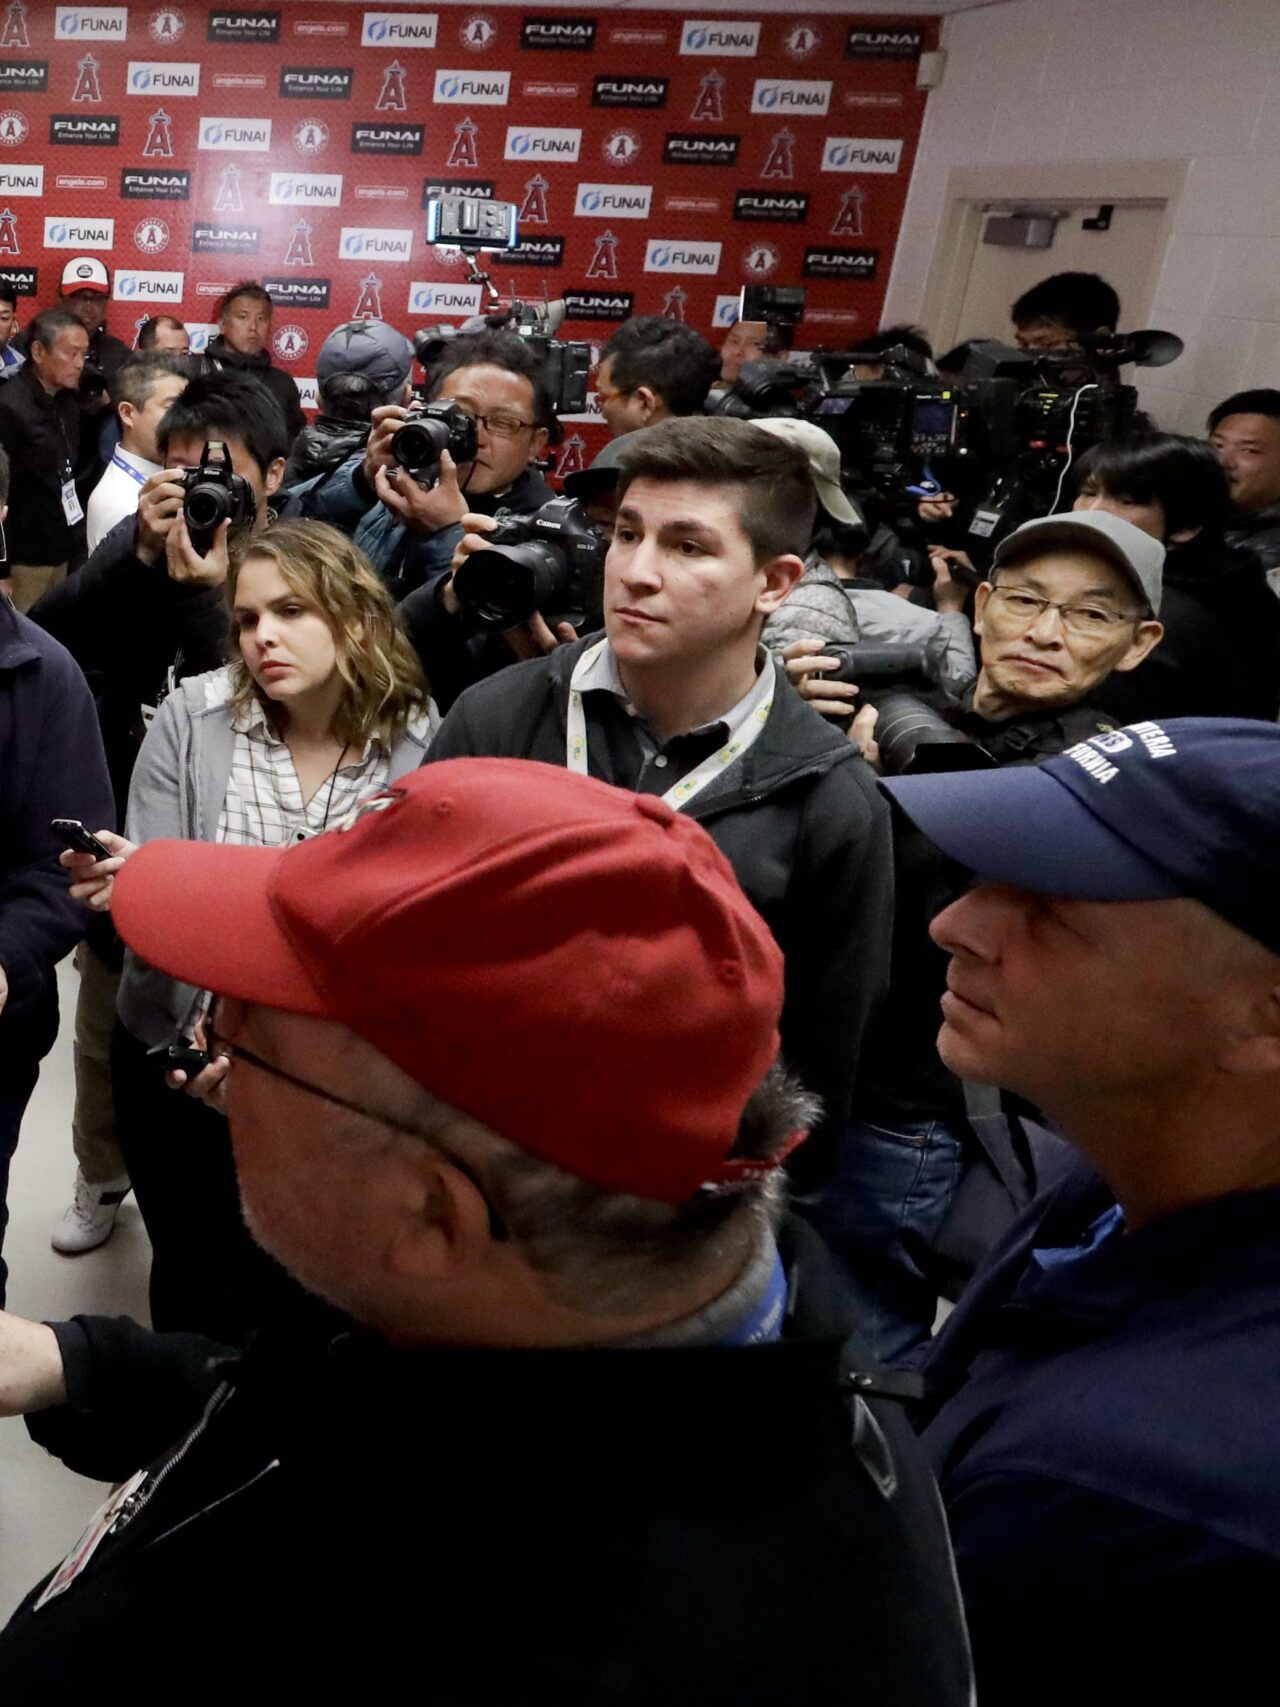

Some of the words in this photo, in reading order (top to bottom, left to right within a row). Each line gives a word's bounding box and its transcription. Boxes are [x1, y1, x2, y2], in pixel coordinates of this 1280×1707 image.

[80, 16, 122, 31] FUNAI
[212, 18, 276, 28] FUNAI
[389, 23, 431, 38] FUNAI
[526, 25, 592, 36] FUNAI
[707, 33, 754, 47] FUNAI
[850, 33, 920, 45] FUNAI
[153, 72, 194, 87] FUNAI
[284, 74, 349, 85] FUNAI
[461, 80, 504, 95] FUNAI
[597, 83, 664, 94] FUNAI
[779, 91, 825, 106] FUNAI
[54, 122, 116, 131] FUNAI
[224, 127, 266, 142] FUNAI
[356, 130, 420, 141] FUNAI
[532, 139, 575, 152] FUNAI
[668, 141, 735, 152] FUNAI
[850, 149, 895, 163] FUNAI
[0, 174, 38, 188] FUNAI
[58, 179, 105, 187] angels.com
[125, 176, 187, 186] FUNAI
[295, 182, 336, 197] FUNAI
[426, 186, 491, 197] FUNAI
[603, 195, 646, 209] FUNAI
[738, 198, 805, 209] FUNAI
[69, 227, 109, 241] FUNAI
[195, 230, 257, 240] FUNAI
[365, 237, 407, 252] FUNAI
[672, 251, 715, 265] FUNAI
[807, 254, 874, 266] FUNAI
[138, 280, 178, 295] FUNAI
[265, 284, 326, 295] FUNAI
[435, 292, 476, 307] FUNAI
[565, 297, 630, 309] FUNAI
[536, 519, 561, 529] Canon
[1062, 742, 1120, 784] FORNIA
